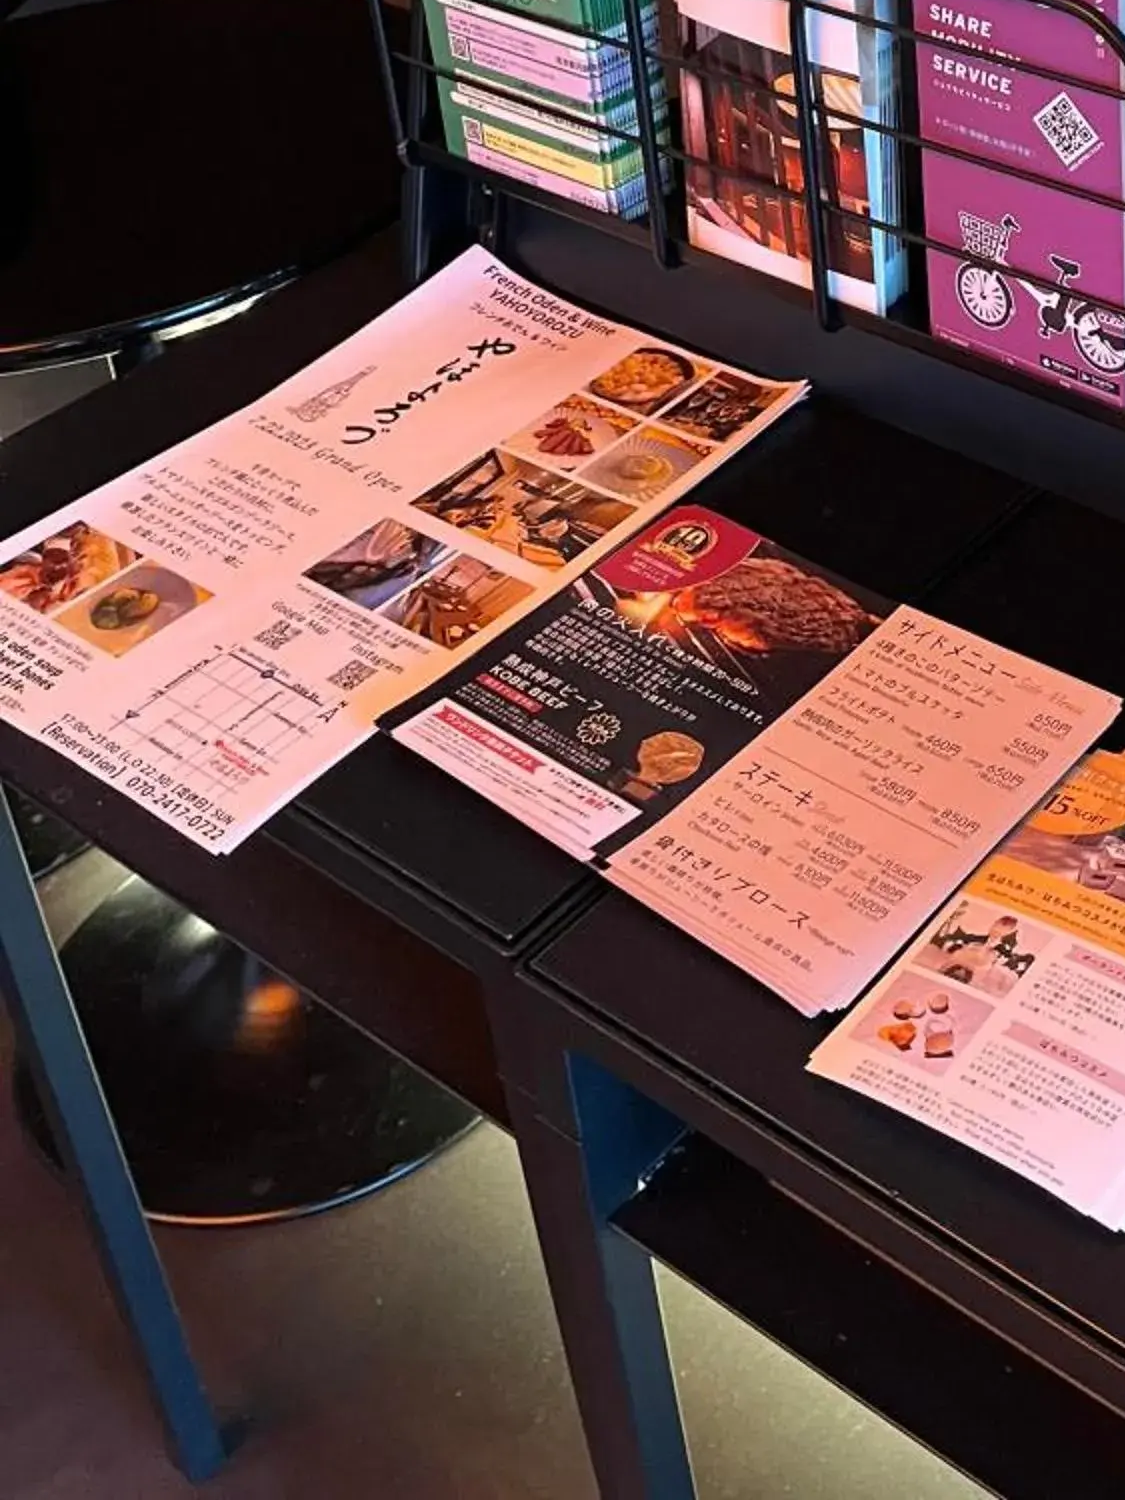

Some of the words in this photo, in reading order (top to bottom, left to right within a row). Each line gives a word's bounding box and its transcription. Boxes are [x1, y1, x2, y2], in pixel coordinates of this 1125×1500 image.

[929, 3, 992, 37] SHARE
[933, 55, 1013, 95] SERVICE
[483, 266, 531, 297] French
[532, 293, 568, 319] Oden
[581, 316, 616, 337] Wine
[489, 288, 585, 339] YAHOYOROZU
[315, 447, 357, 475] Grand
[363, 468, 403, 494] Open
[272, 601, 303, 621] Google
[8, 642, 36, 660] oden
[34, 659, 63, 676] soup
[900, 619, 1016, 679] サイドメニュー
[490, 665, 525, 691] KOBE
[528, 686, 568, 710] BEEF
[739, 761, 814, 807] ステーキ
[1043, 793, 1075, 816] 15
[126, 777, 225, 840] 070-2417-0722
[214, 808, 235, 825] SUN
